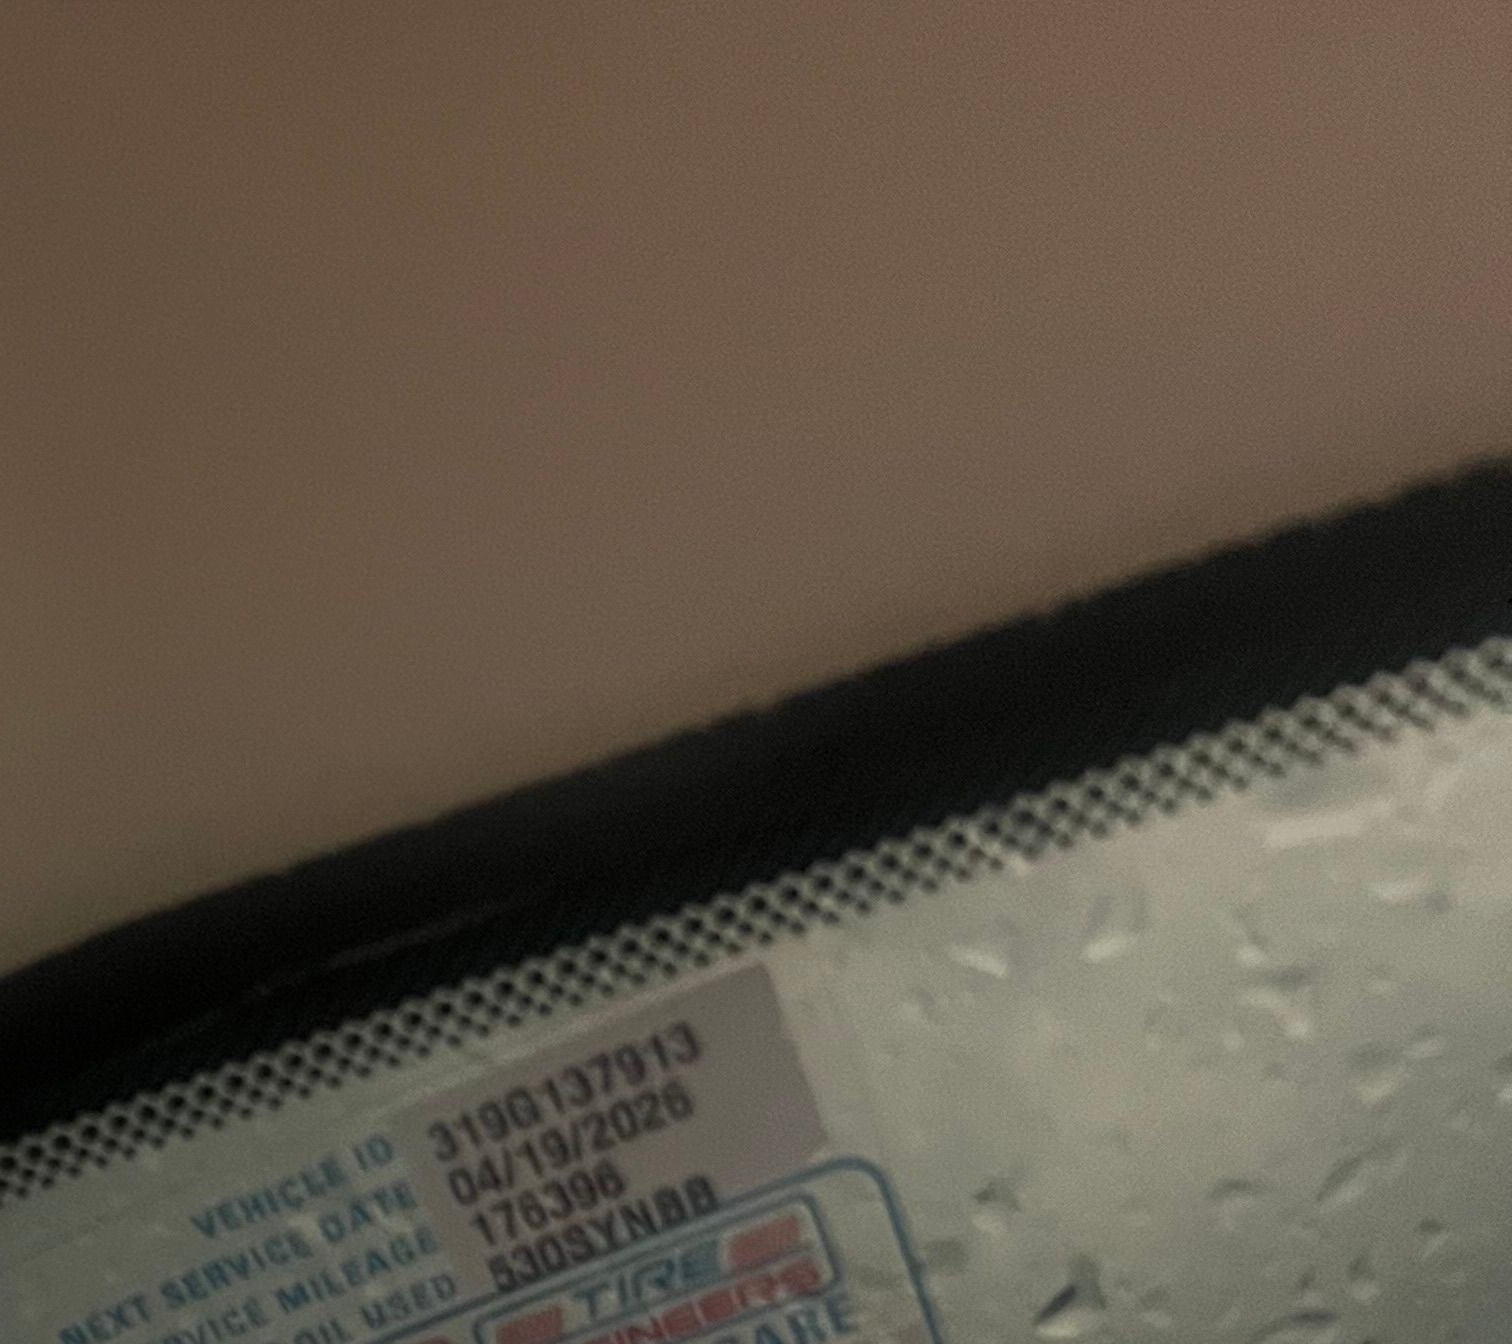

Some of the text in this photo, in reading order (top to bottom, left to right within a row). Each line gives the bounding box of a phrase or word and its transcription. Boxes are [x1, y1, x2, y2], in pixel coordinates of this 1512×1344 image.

[161, 1231, 314, 1309] SERVICE
[319, 1181, 418, 1244] DATE
[447, 1080, 694, 1204] 04/19/2026
[192, 1154, 346, 1238] VEHICLE
[353, 1133, 393, 1174] ID
[276, 1227, 436, 1312] MILEAGE
[361, 1274, 455, 1328] USED
[572, 1239, 720, 1320] TIRE
